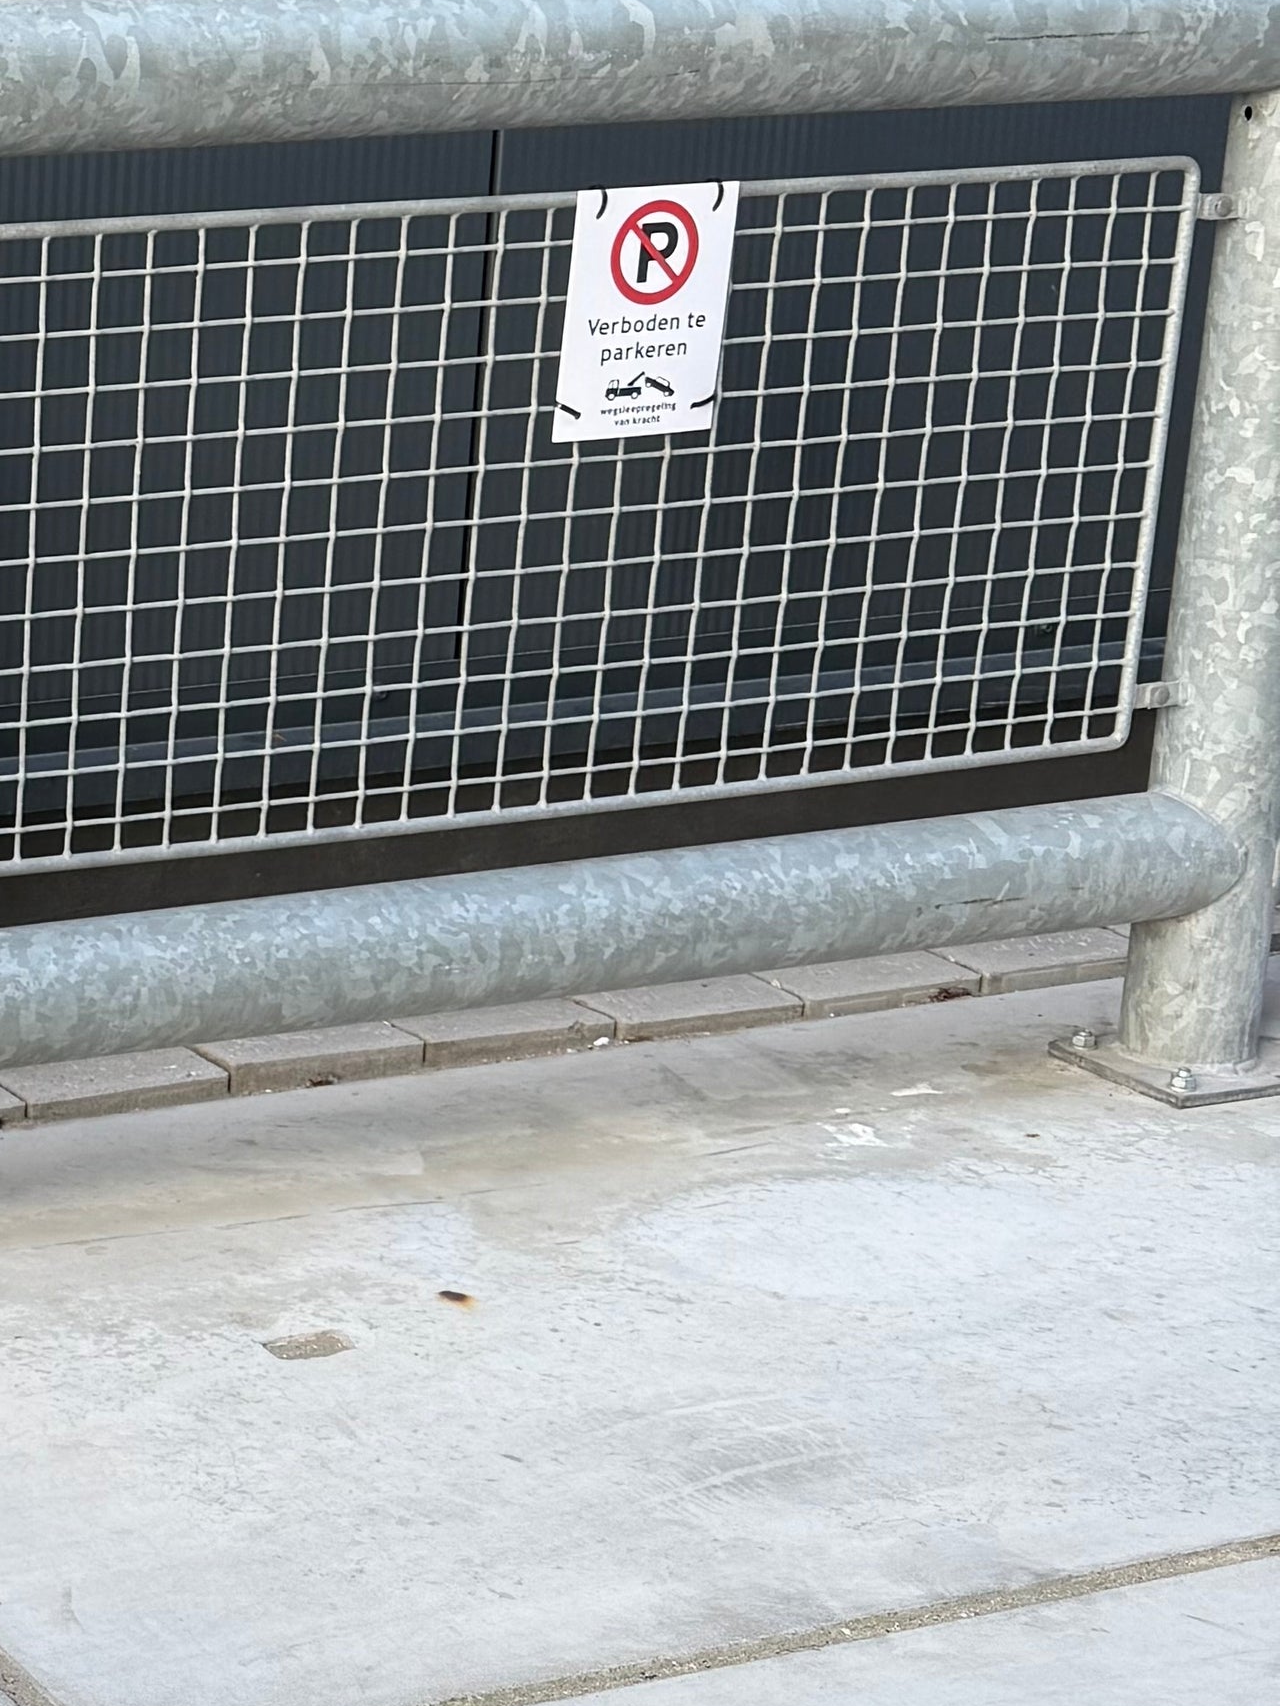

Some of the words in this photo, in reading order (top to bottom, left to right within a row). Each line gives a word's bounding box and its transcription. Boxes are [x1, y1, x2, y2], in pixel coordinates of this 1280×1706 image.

[588, 313, 680, 336] Verboden
[687, 312, 706, 329] te
[600, 341, 687, 366] parkeren
[614, 418, 630, 426] van
[632, 415, 660, 425] kracht
